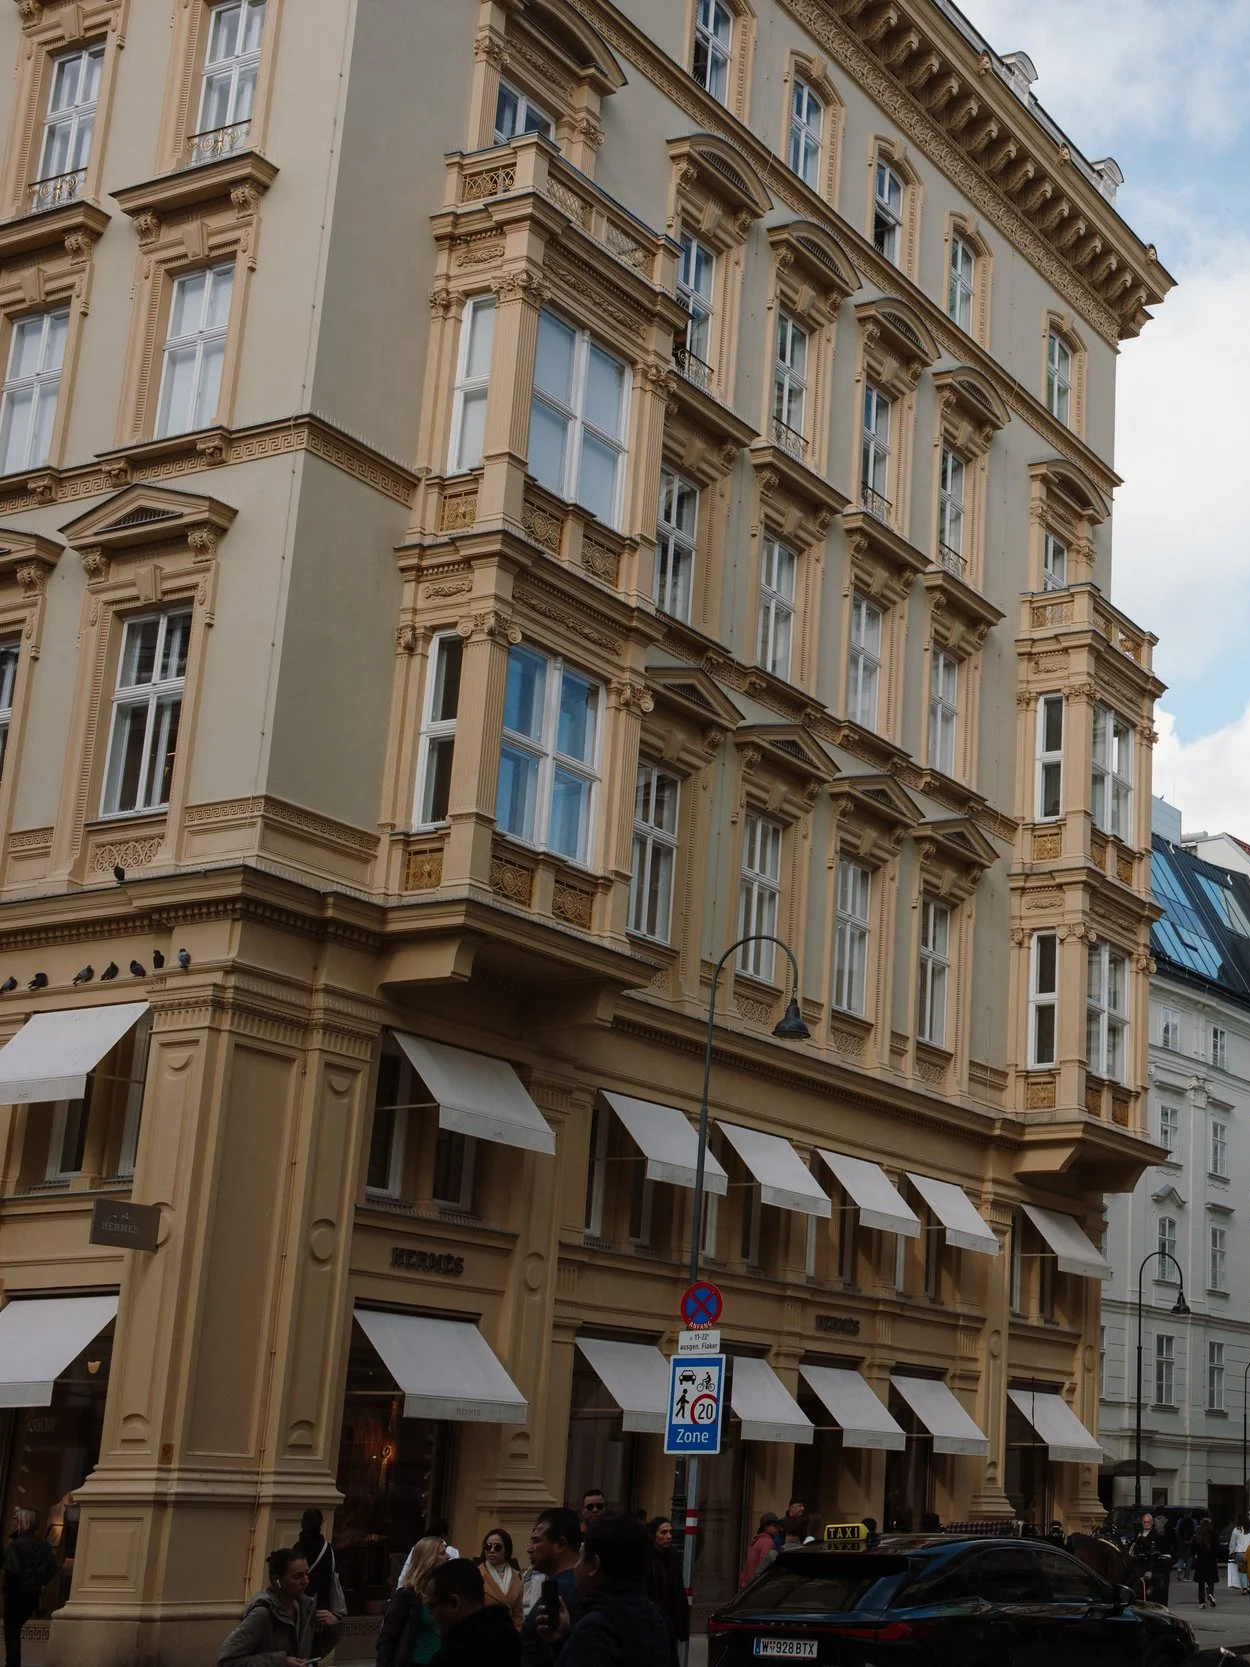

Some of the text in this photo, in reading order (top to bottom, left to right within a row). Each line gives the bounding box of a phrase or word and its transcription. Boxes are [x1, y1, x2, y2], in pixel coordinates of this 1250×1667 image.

[689, 1321, 712, 1330] ANFANG
[698, 1403, 714, 1420] 20
[676, 1428, 709, 1443] Zone
[829, 1527, 859, 1539] TAXI
